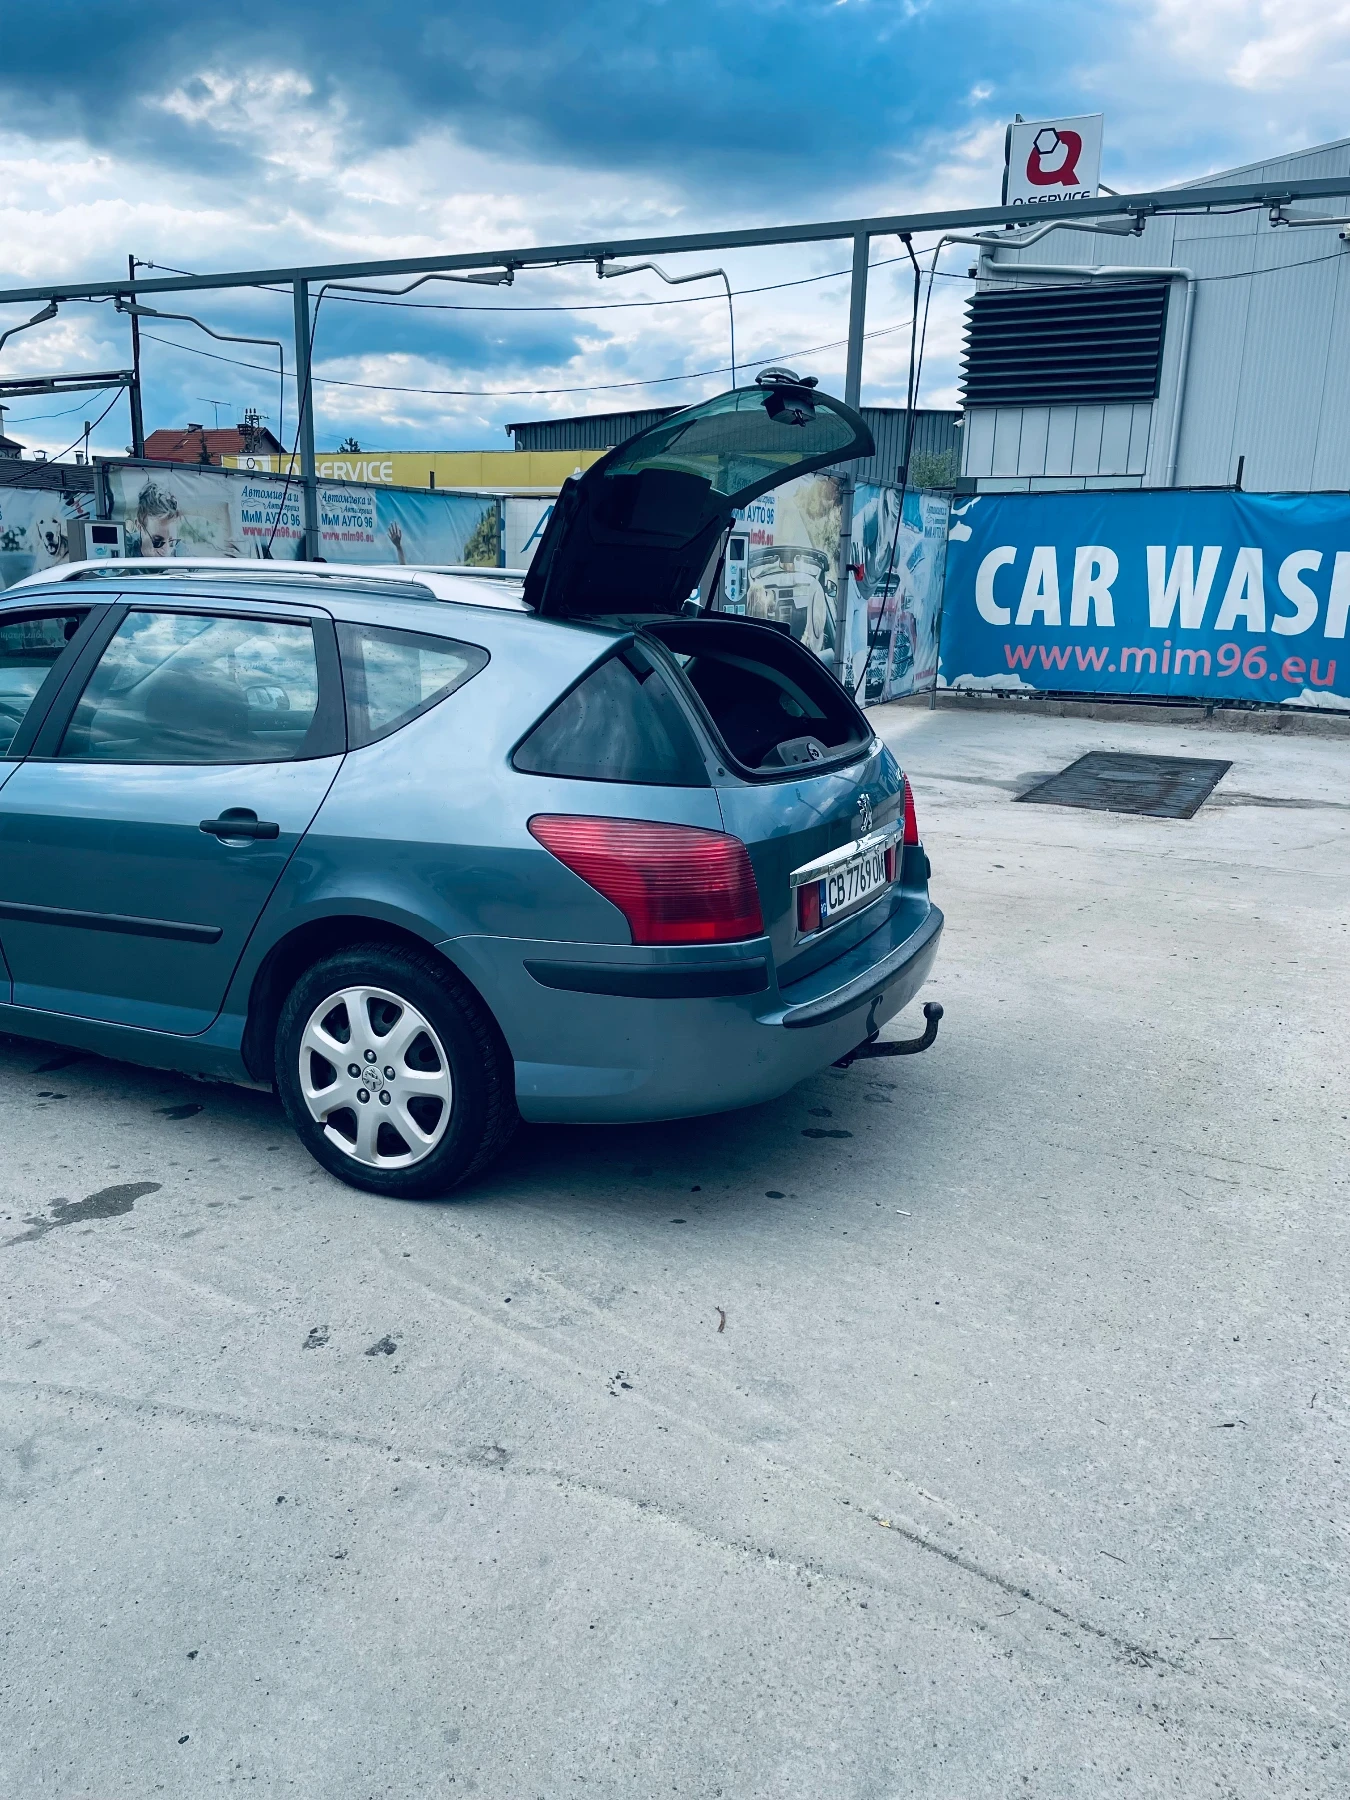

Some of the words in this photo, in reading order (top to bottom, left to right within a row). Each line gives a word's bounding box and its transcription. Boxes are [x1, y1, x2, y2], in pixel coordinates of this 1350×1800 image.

[241, 486, 292, 502] Автомива
[242, 510, 263, 524] МиМ
[291, 514, 301, 527] 96
[321, 513, 340, 526] МиМ
[342, 515, 363, 528] АУТО
[364, 517, 373, 529] 96
[747, 505, 766, 524] АУТО
[766, 508, 775, 525] 96
[975, 545, 1120, 626] CAR
[1004, 640, 1338, 687] www.mim96.eu
[828, 873, 846, 909] CB
[846, 859, 872, 901] 7769
